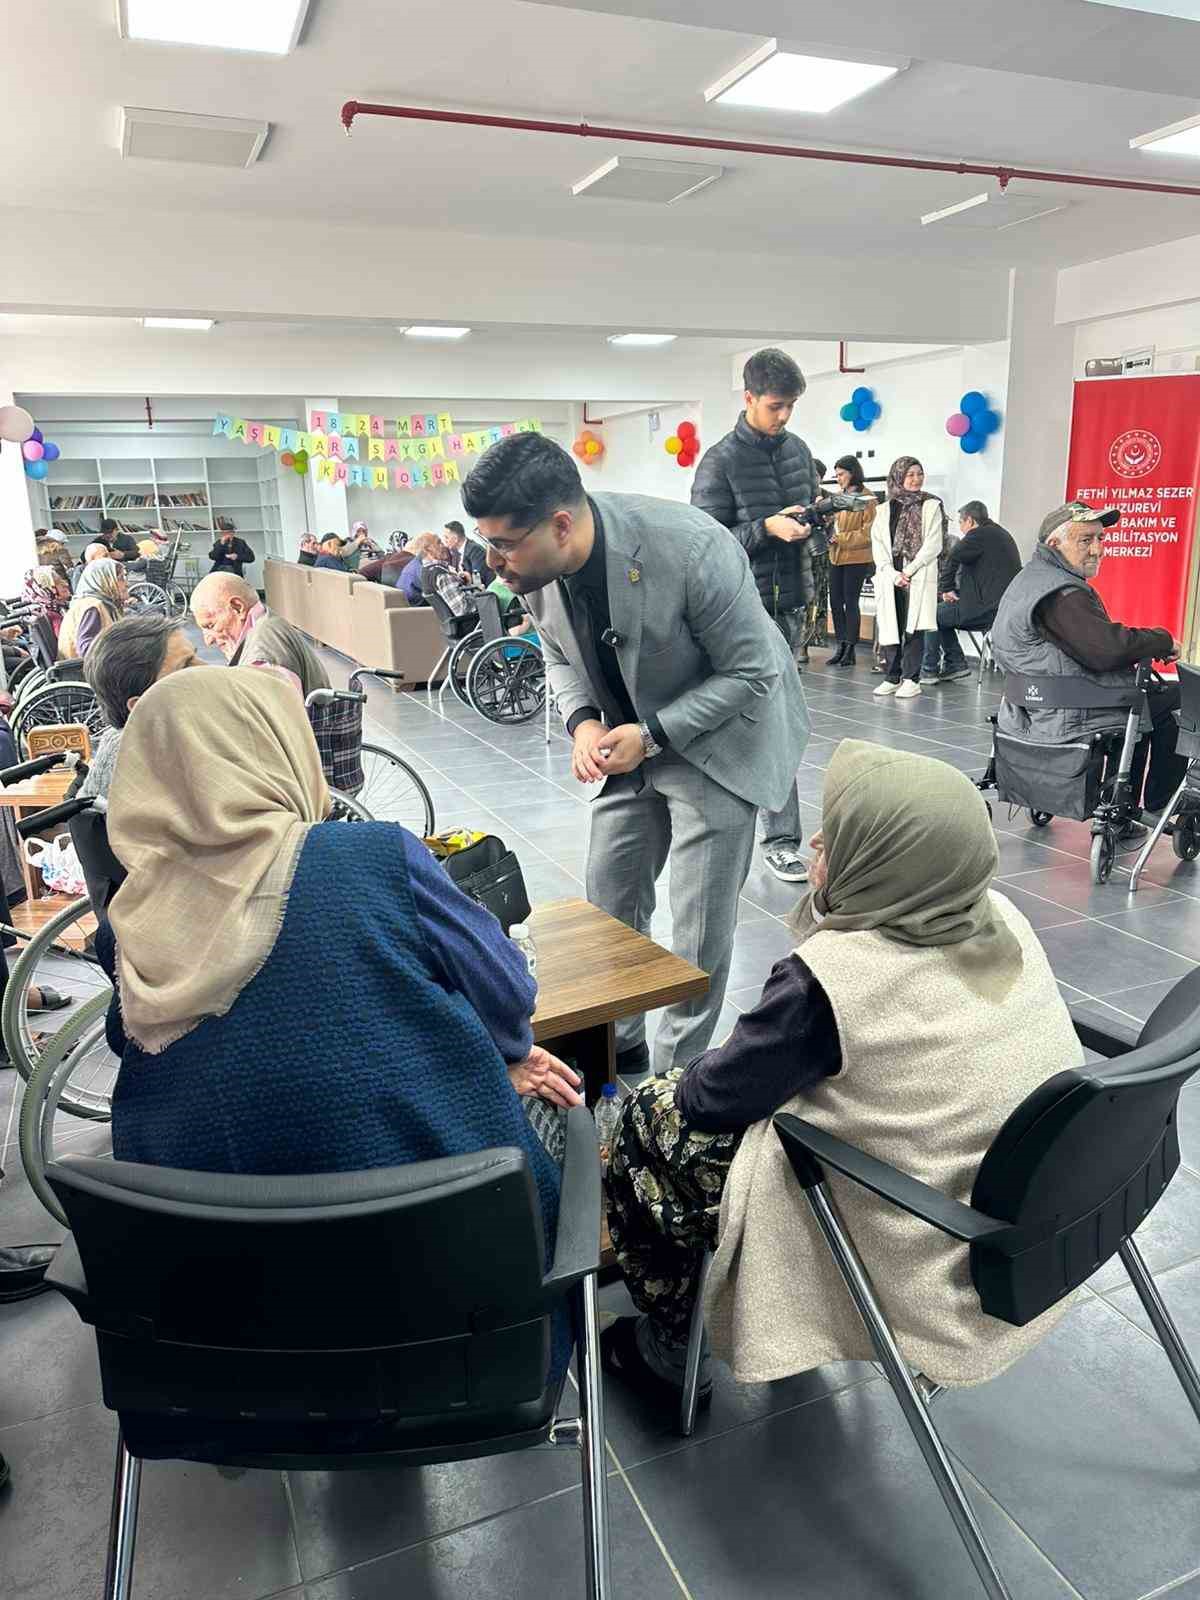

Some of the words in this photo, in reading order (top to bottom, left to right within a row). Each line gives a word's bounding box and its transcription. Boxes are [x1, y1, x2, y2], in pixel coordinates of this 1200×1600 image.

[398, 418, 448, 431] MART
[373, 442, 437, 455] SAYGI
[323, 465, 385, 483] KUTLU
[400, 468, 454, 483] OLSUN
[1076, 486, 1108, 500] FETHİ
[1111, 487, 1153, 499] YILMAZ
[1156, 487, 1194, 498] SEZER
[1121, 517, 1157, 528] BAKIM
[1161, 517, 1177, 528] VE
[1103, 530, 1179, 543] ABİLİTASYON
[1103, 544, 1153, 557] MERKEZİ
